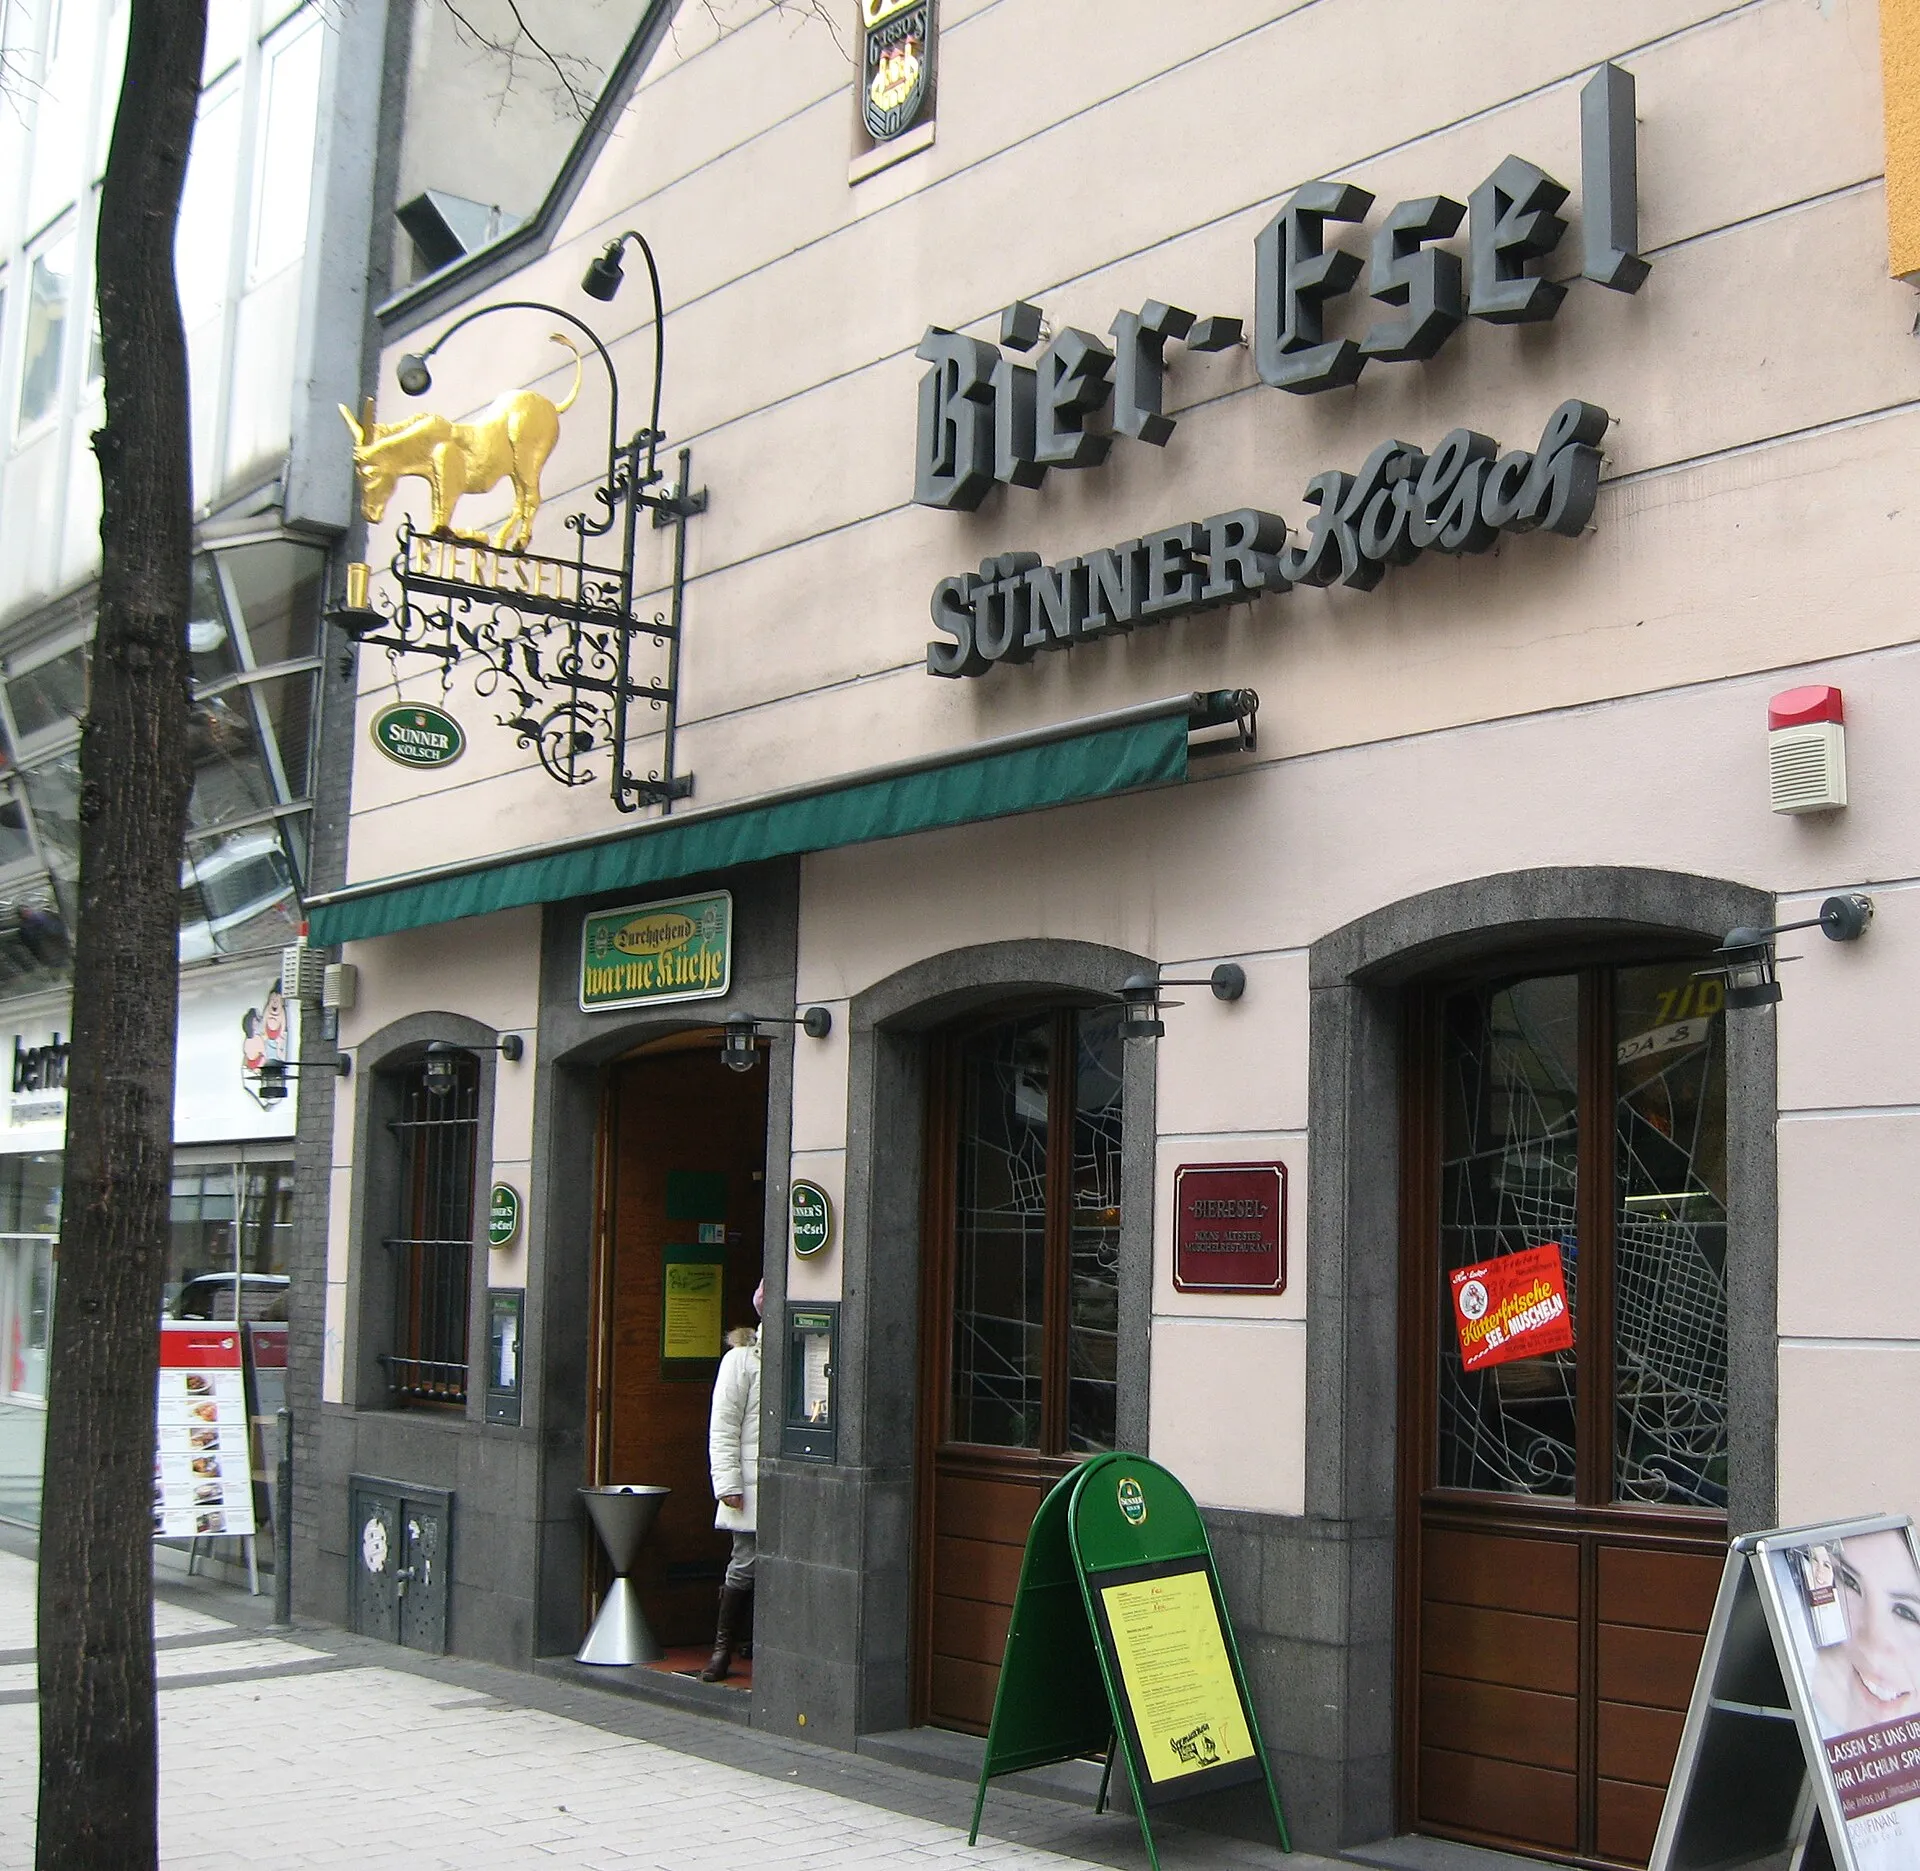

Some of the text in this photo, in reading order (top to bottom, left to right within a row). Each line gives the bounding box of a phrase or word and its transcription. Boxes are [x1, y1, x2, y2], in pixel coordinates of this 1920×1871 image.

[926, 398, 1609, 680] SÜNNER Kölsch
[618, 918, 692, 948] Durchgehend
[585, 943, 722, 996] warme Küche
[1461, 1278, 1553, 1347] Kutterfrische
[1508, 1292, 1564, 1338] MUSCHELN
[1827, 1738, 1868, 1764] LASSEN
[1882, 1726, 1907, 1747] UNS
[1834, 1768, 1856, 1790] IHR
